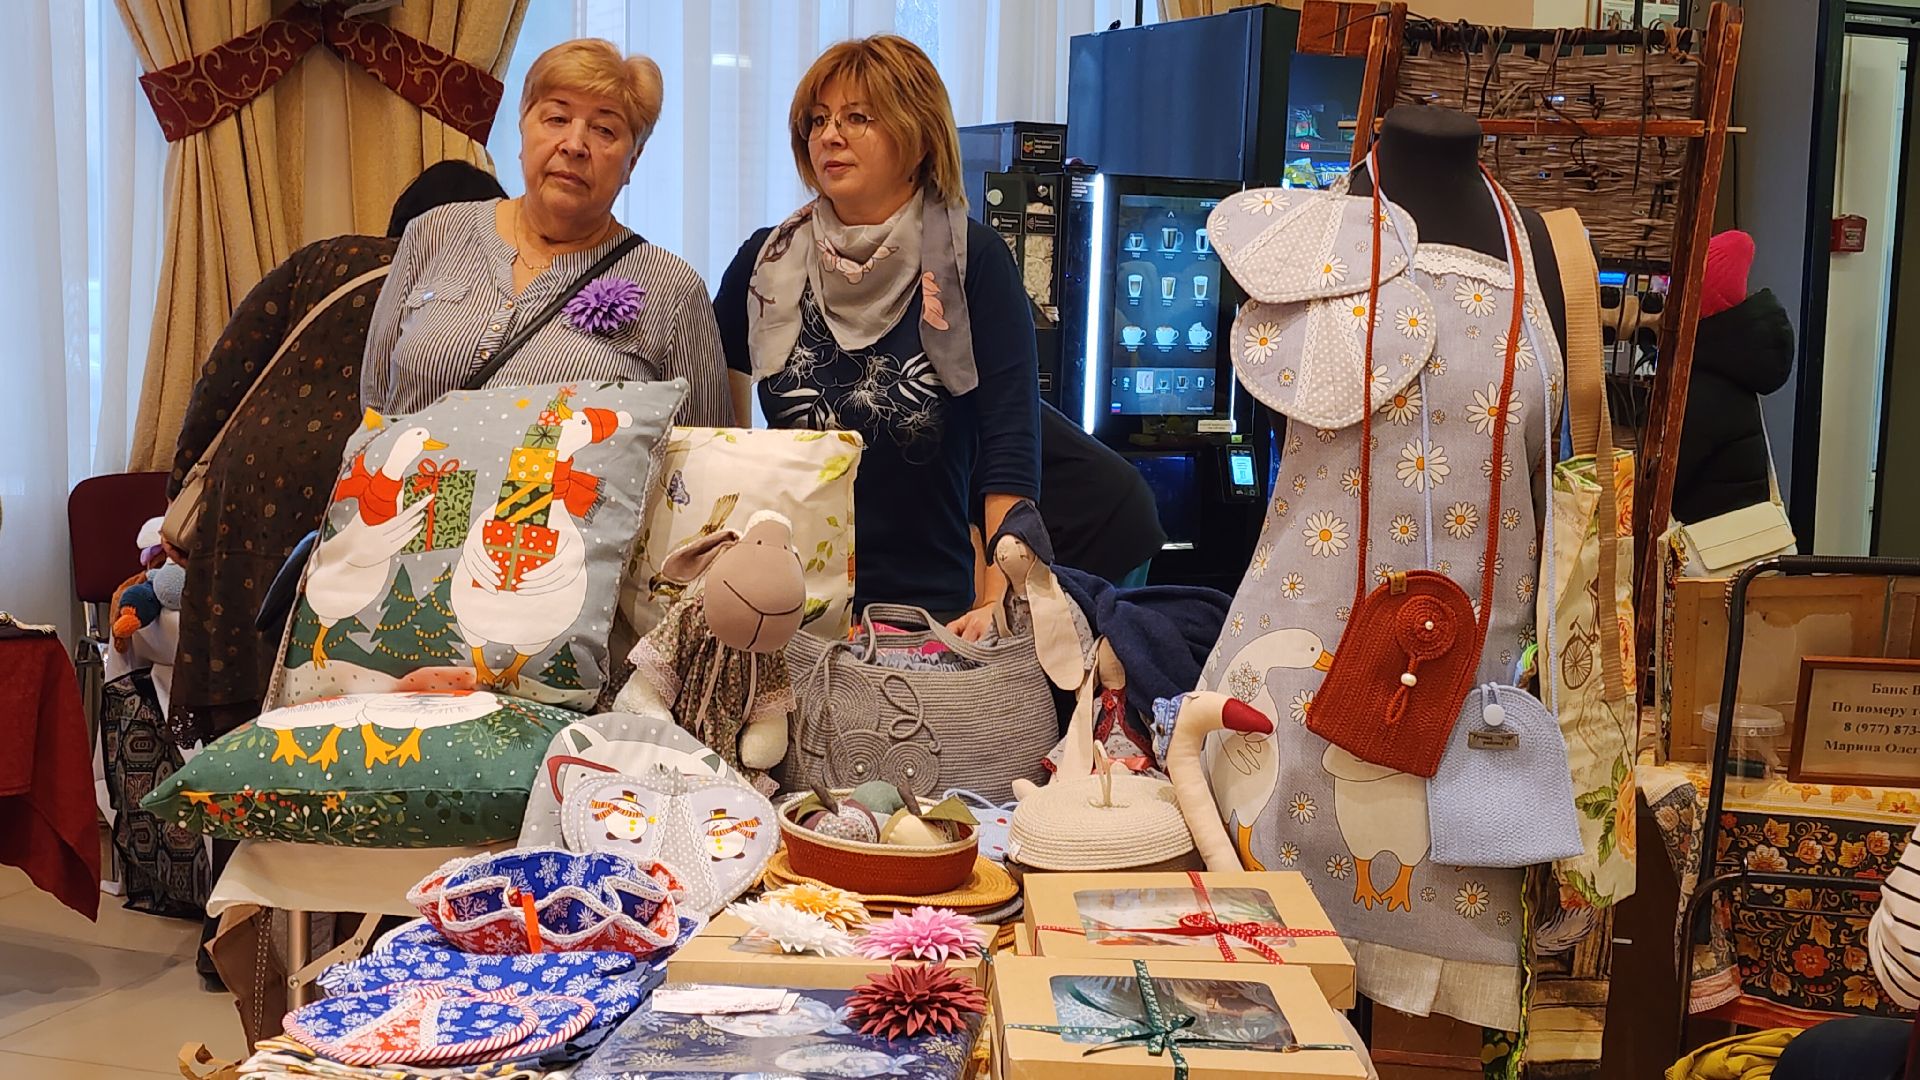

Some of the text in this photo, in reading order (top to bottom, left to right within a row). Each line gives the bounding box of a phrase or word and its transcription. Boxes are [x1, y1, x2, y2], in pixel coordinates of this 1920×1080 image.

[1872, 683, 1908, 695] Банк
[1832, 702, 1851, 712] По
[1856, 705, 1907, 717] номеру
[1844, 722, 1851, 732] 8
[1856, 723, 1889, 735] (977)
[1824, 741, 1880, 753] Марина
